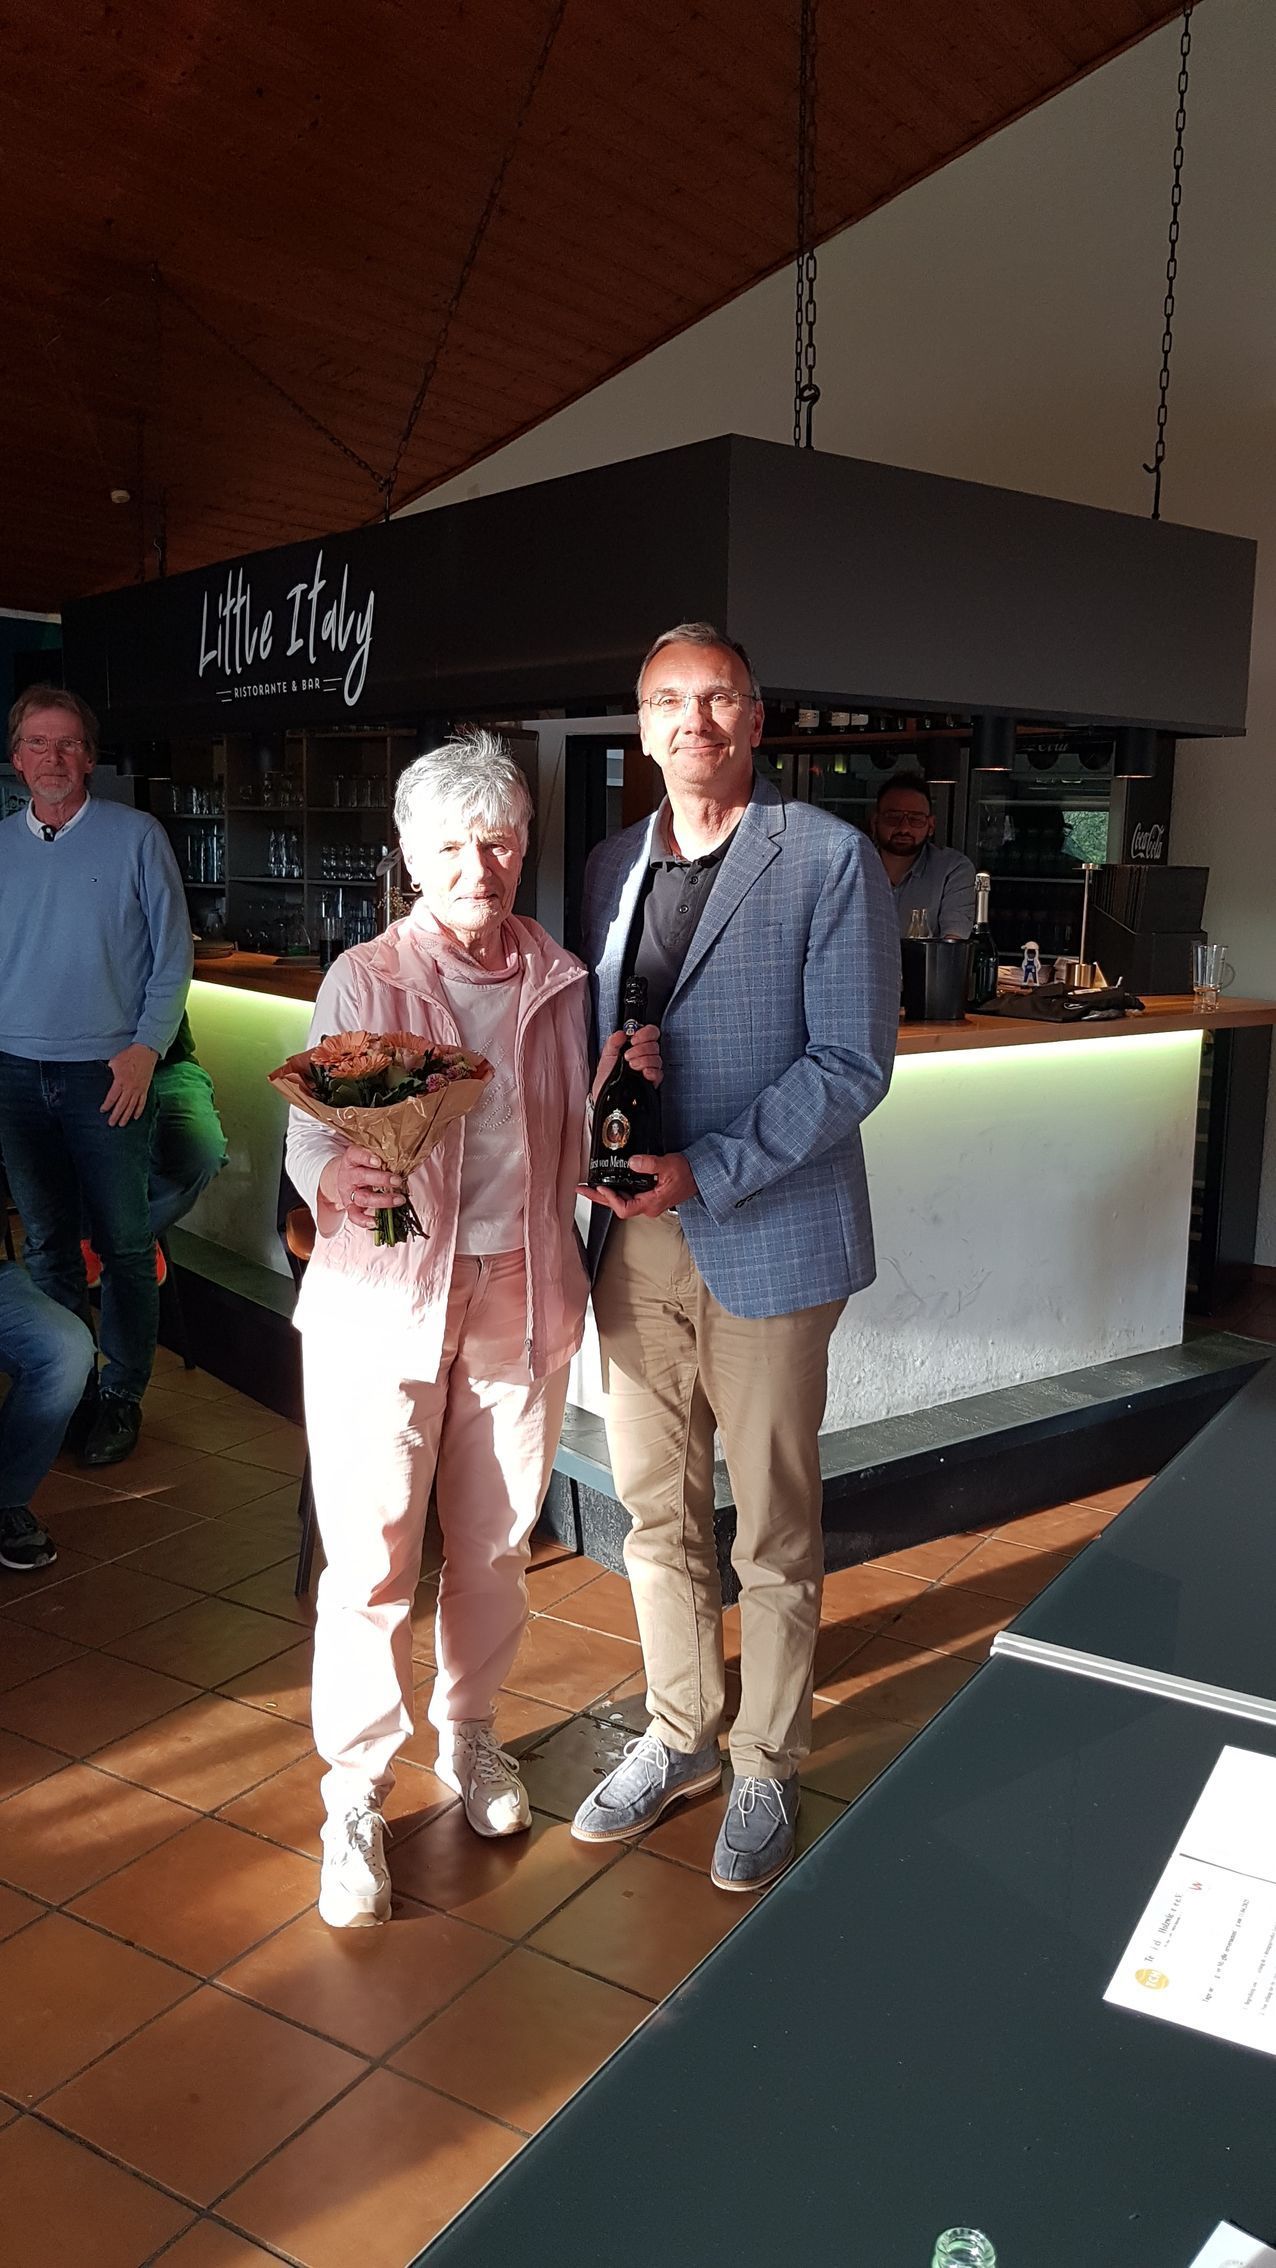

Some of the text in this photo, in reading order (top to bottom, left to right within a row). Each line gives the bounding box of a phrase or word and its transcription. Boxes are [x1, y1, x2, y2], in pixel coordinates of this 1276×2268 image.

[199, 549, 375, 706] Little Italy
[234, 677, 320, 698] RISTORANTE & BAR
